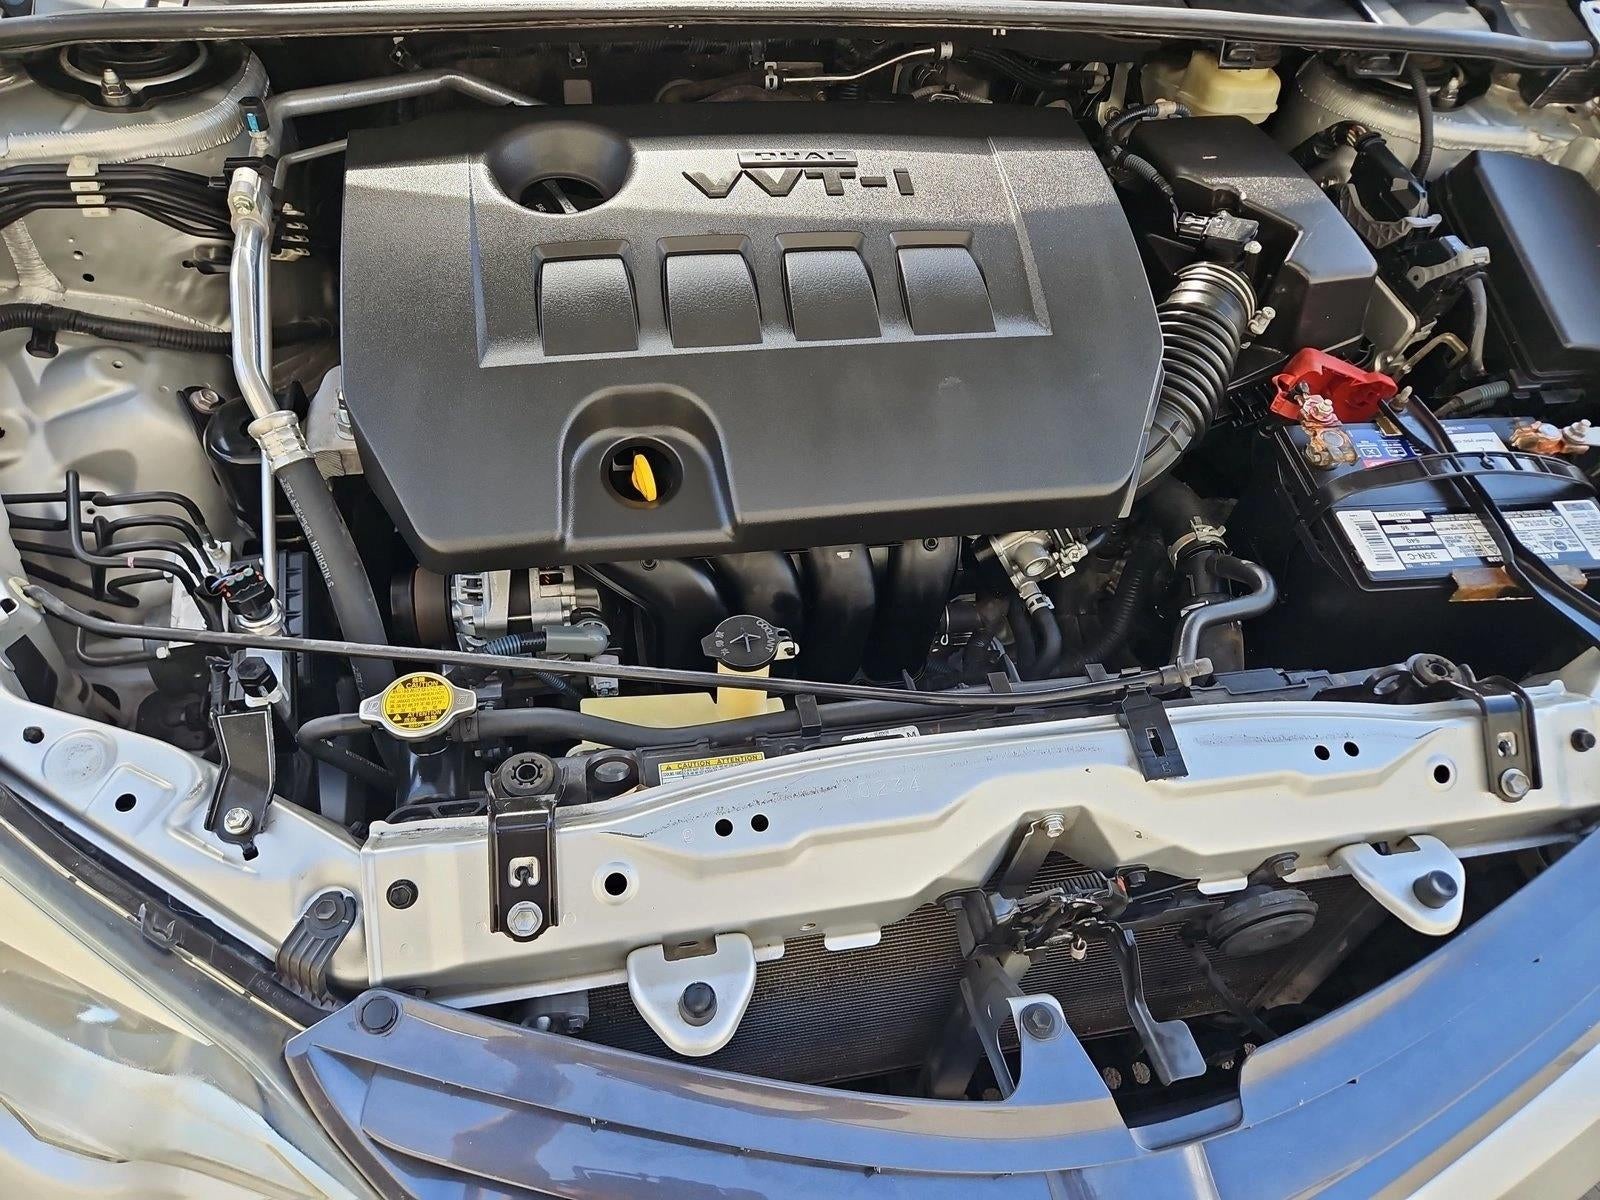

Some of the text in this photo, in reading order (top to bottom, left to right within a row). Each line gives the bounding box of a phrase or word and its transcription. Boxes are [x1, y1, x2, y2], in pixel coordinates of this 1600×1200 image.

[754, 151, 847, 160] DUAL
[756, 619, 775, 653] COOLANT
[405, 681, 439, 689] CAUTION
[407, 709, 442, 718] ATTENTION
[677, 760, 711, 770] CAUTION
[717, 754, 758, 764] ATTENTION
